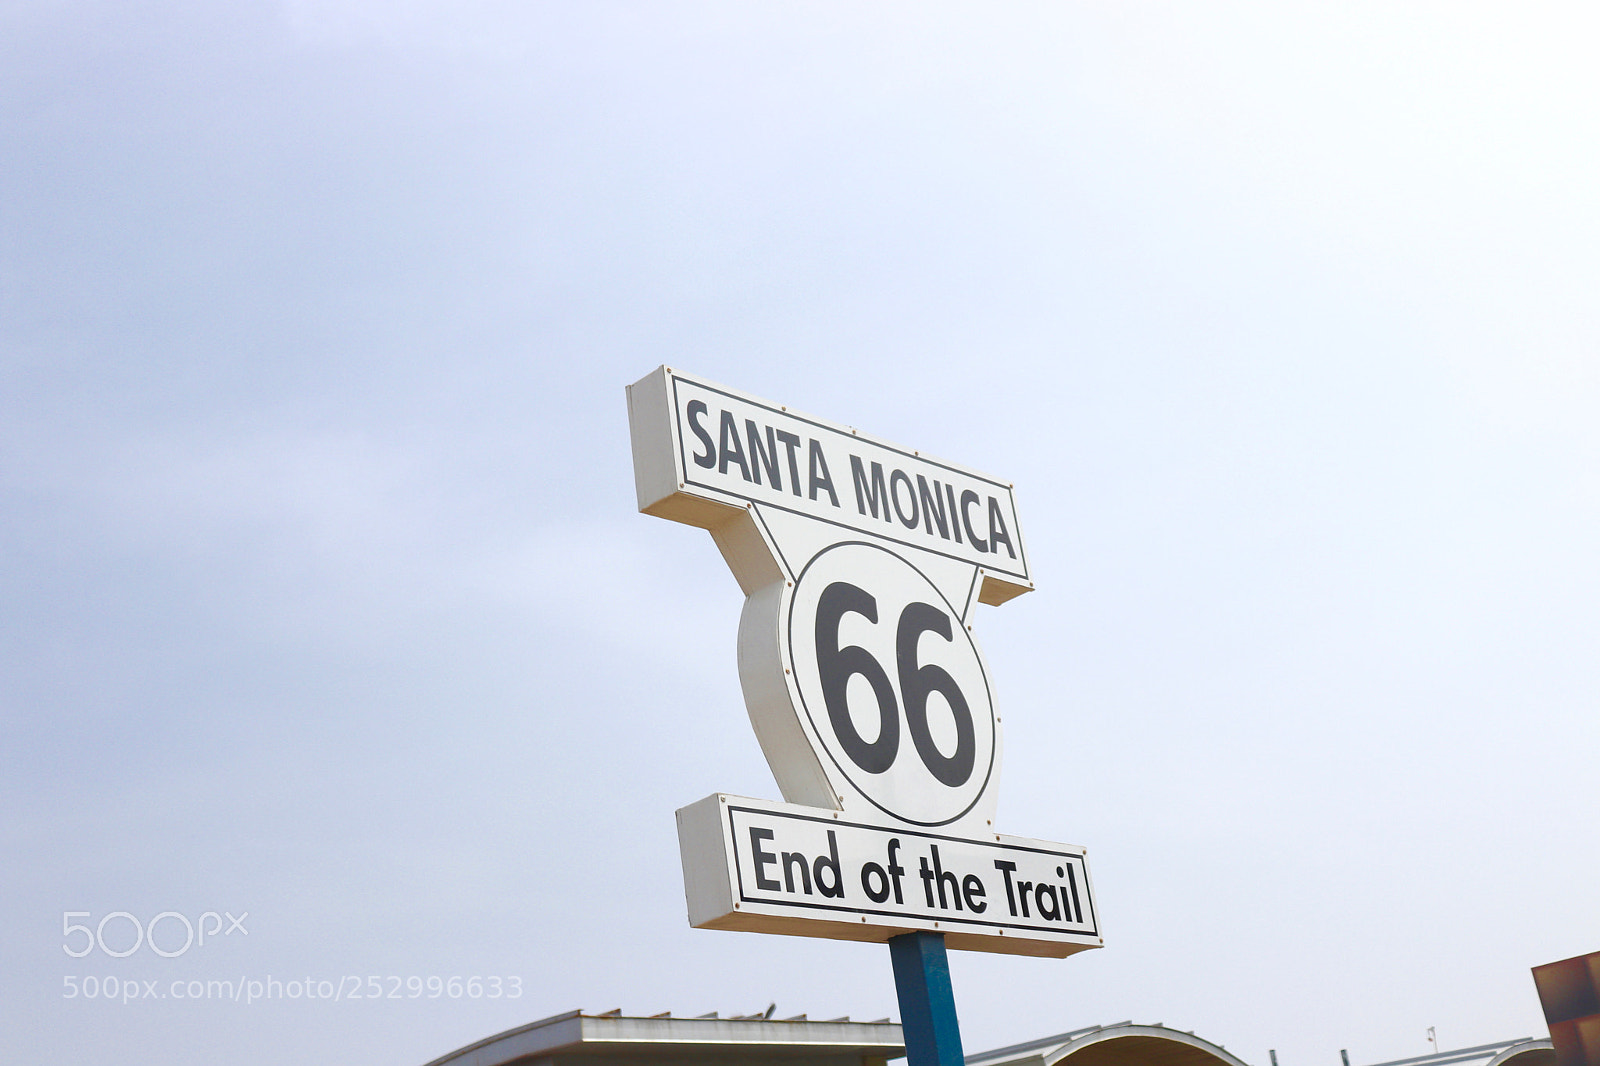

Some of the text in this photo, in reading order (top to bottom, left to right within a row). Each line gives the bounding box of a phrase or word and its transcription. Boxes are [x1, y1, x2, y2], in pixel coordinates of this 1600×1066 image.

[686, 399, 1017, 560] SANTA MONICA
[814, 581, 976, 788] 66
[749, 827, 1084, 924] End of the Trail
